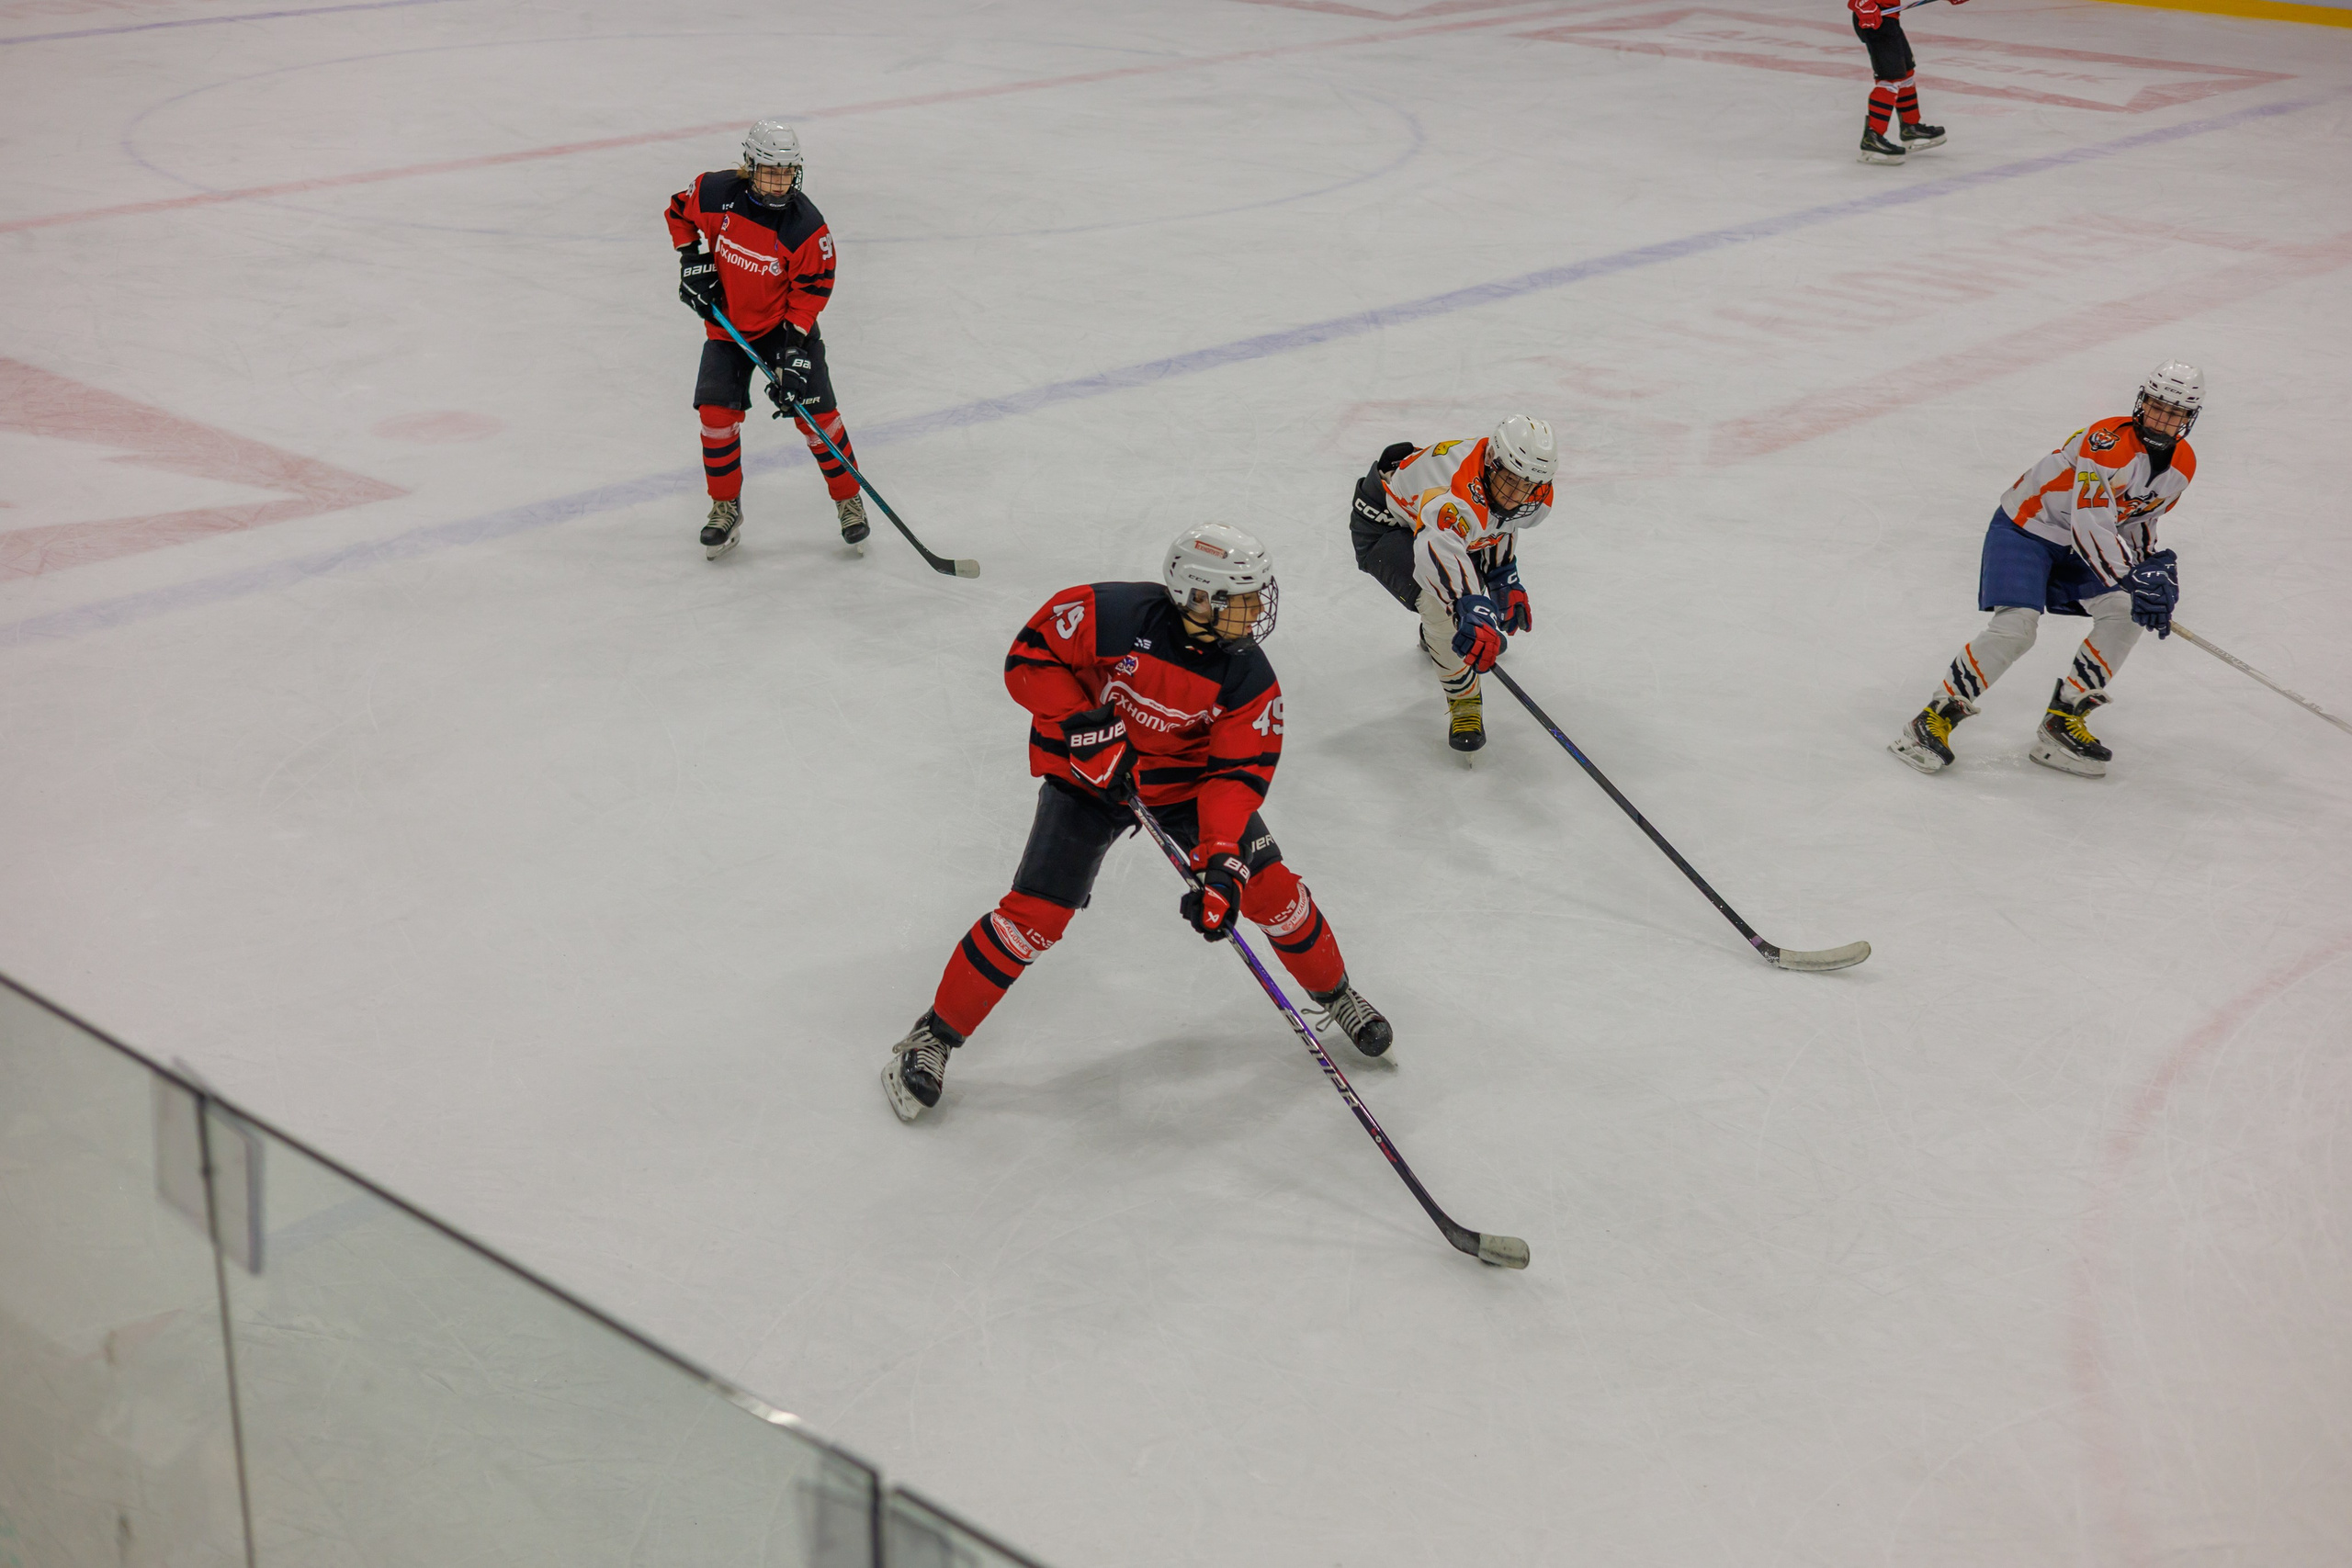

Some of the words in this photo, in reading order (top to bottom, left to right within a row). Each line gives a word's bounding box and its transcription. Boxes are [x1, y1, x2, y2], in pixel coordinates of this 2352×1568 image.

[683, 263, 718, 277] BAUE
[2164, 387, 2183, 395] CCM
[2076, 471, 2109, 510] 22
[1354, 498, 1400, 527] CCM
[1188, 574, 1211, 584] CCM
[1252, 696, 1283, 736] 49
[1070, 720, 1126, 748] BAUE
